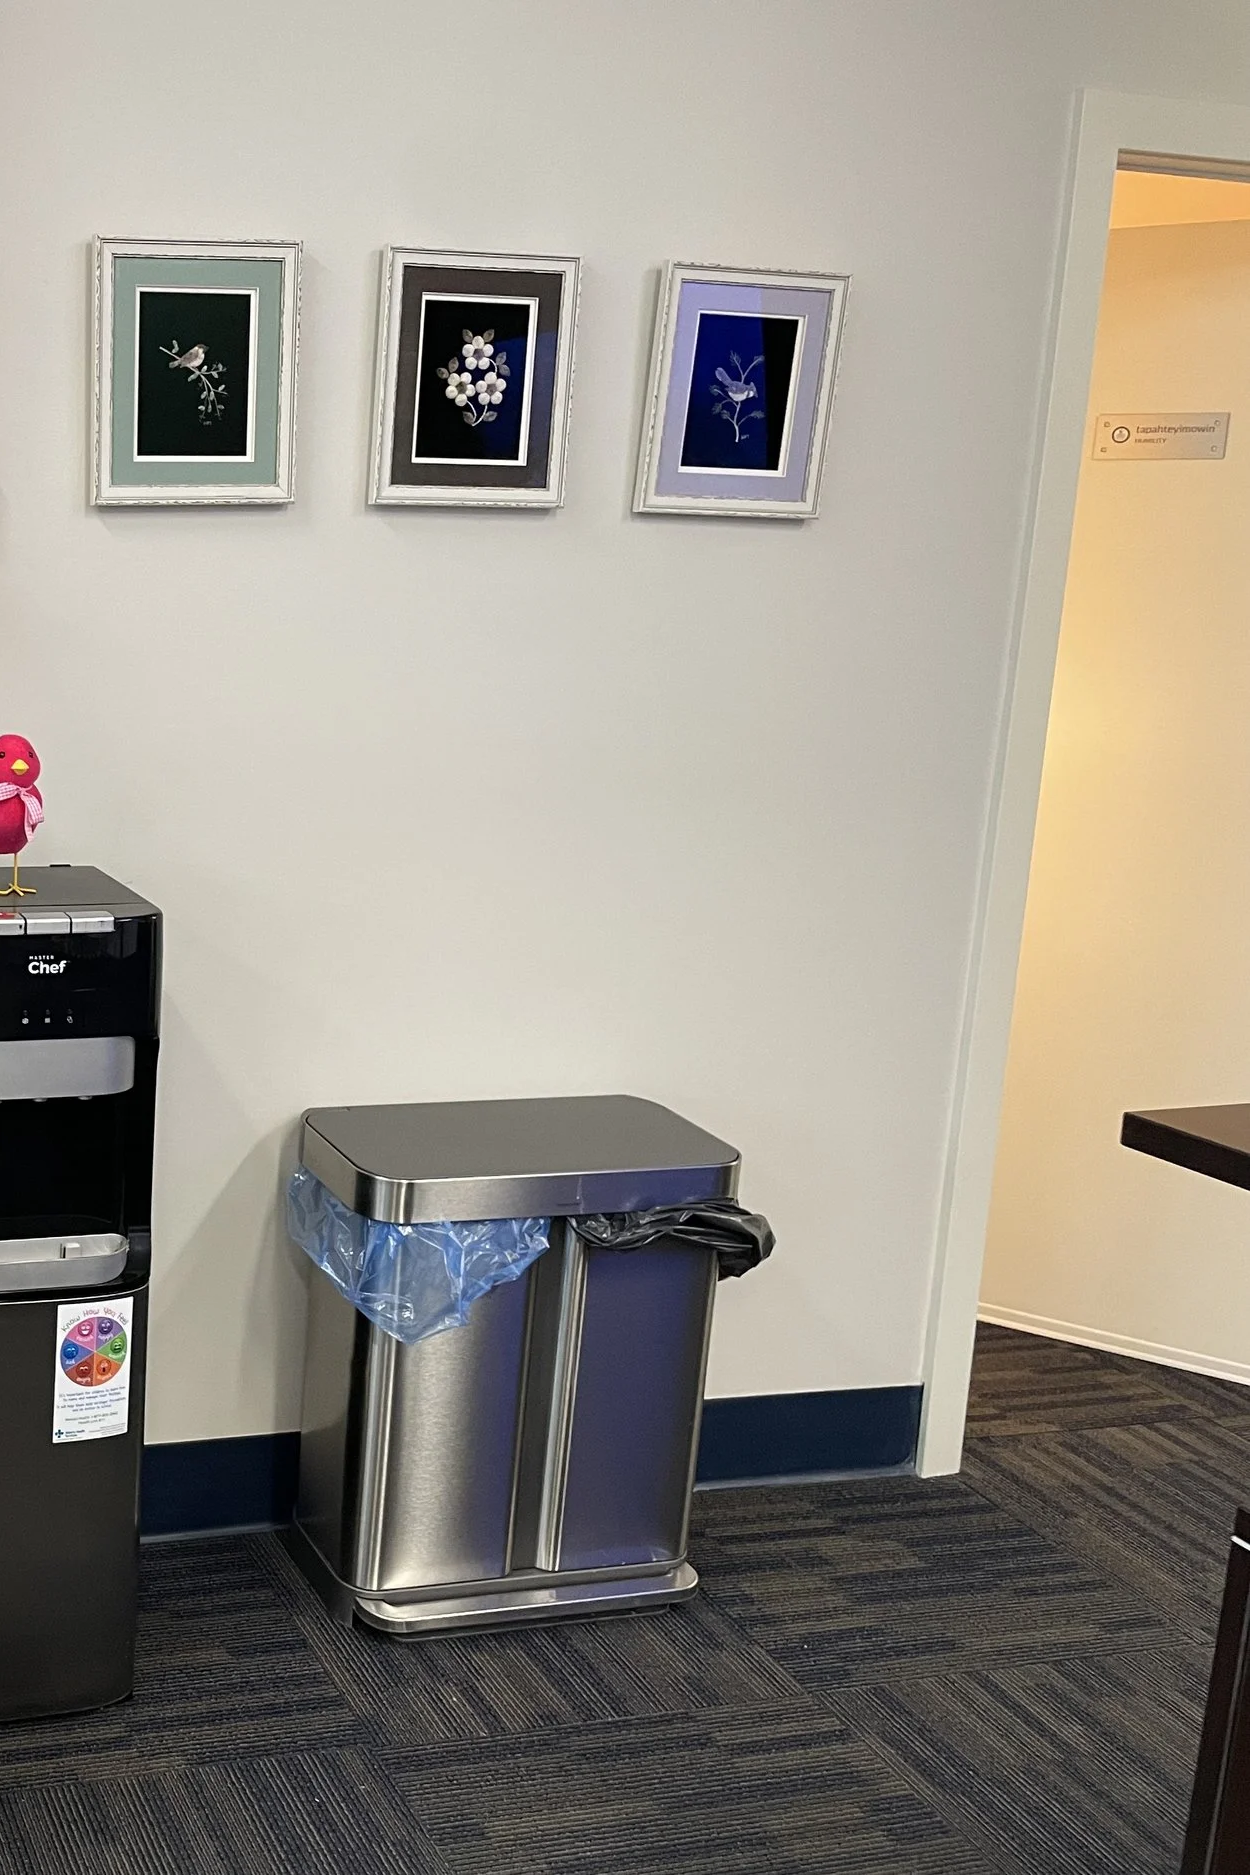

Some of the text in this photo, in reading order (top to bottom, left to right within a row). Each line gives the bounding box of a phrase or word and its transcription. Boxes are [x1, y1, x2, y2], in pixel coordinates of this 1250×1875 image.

[28, 960, 67, 974] Chef
[61, 1315, 81, 1332] Know
[82, 1308, 100, 1317] How
